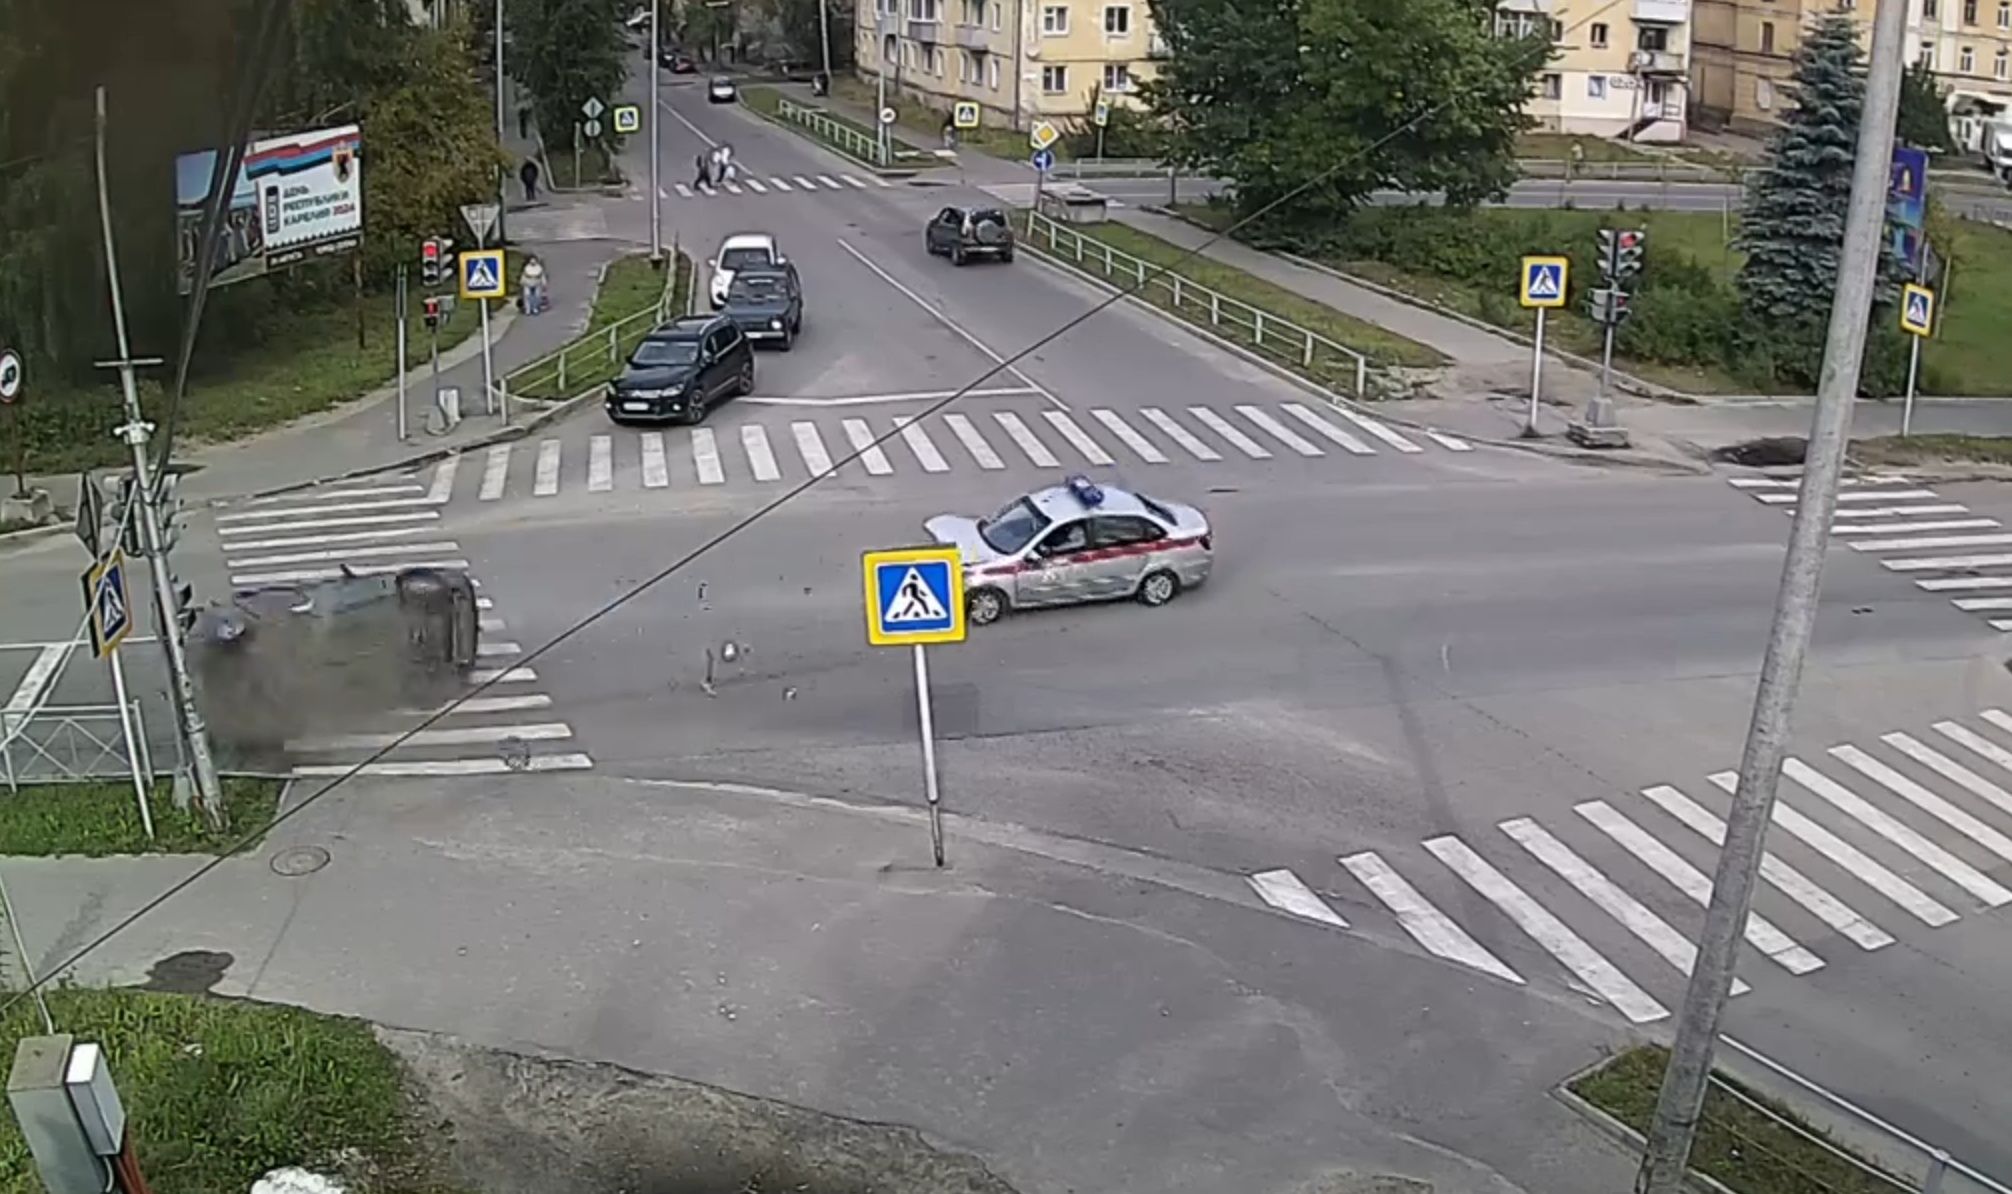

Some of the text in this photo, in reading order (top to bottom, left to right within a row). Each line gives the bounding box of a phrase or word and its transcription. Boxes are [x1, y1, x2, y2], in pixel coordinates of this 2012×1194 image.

[284, 186, 309, 198] ДЕНЬ
[284, 191, 349, 212] РЕСПУБЛИКИ
[333, 203, 355, 216] 2024
